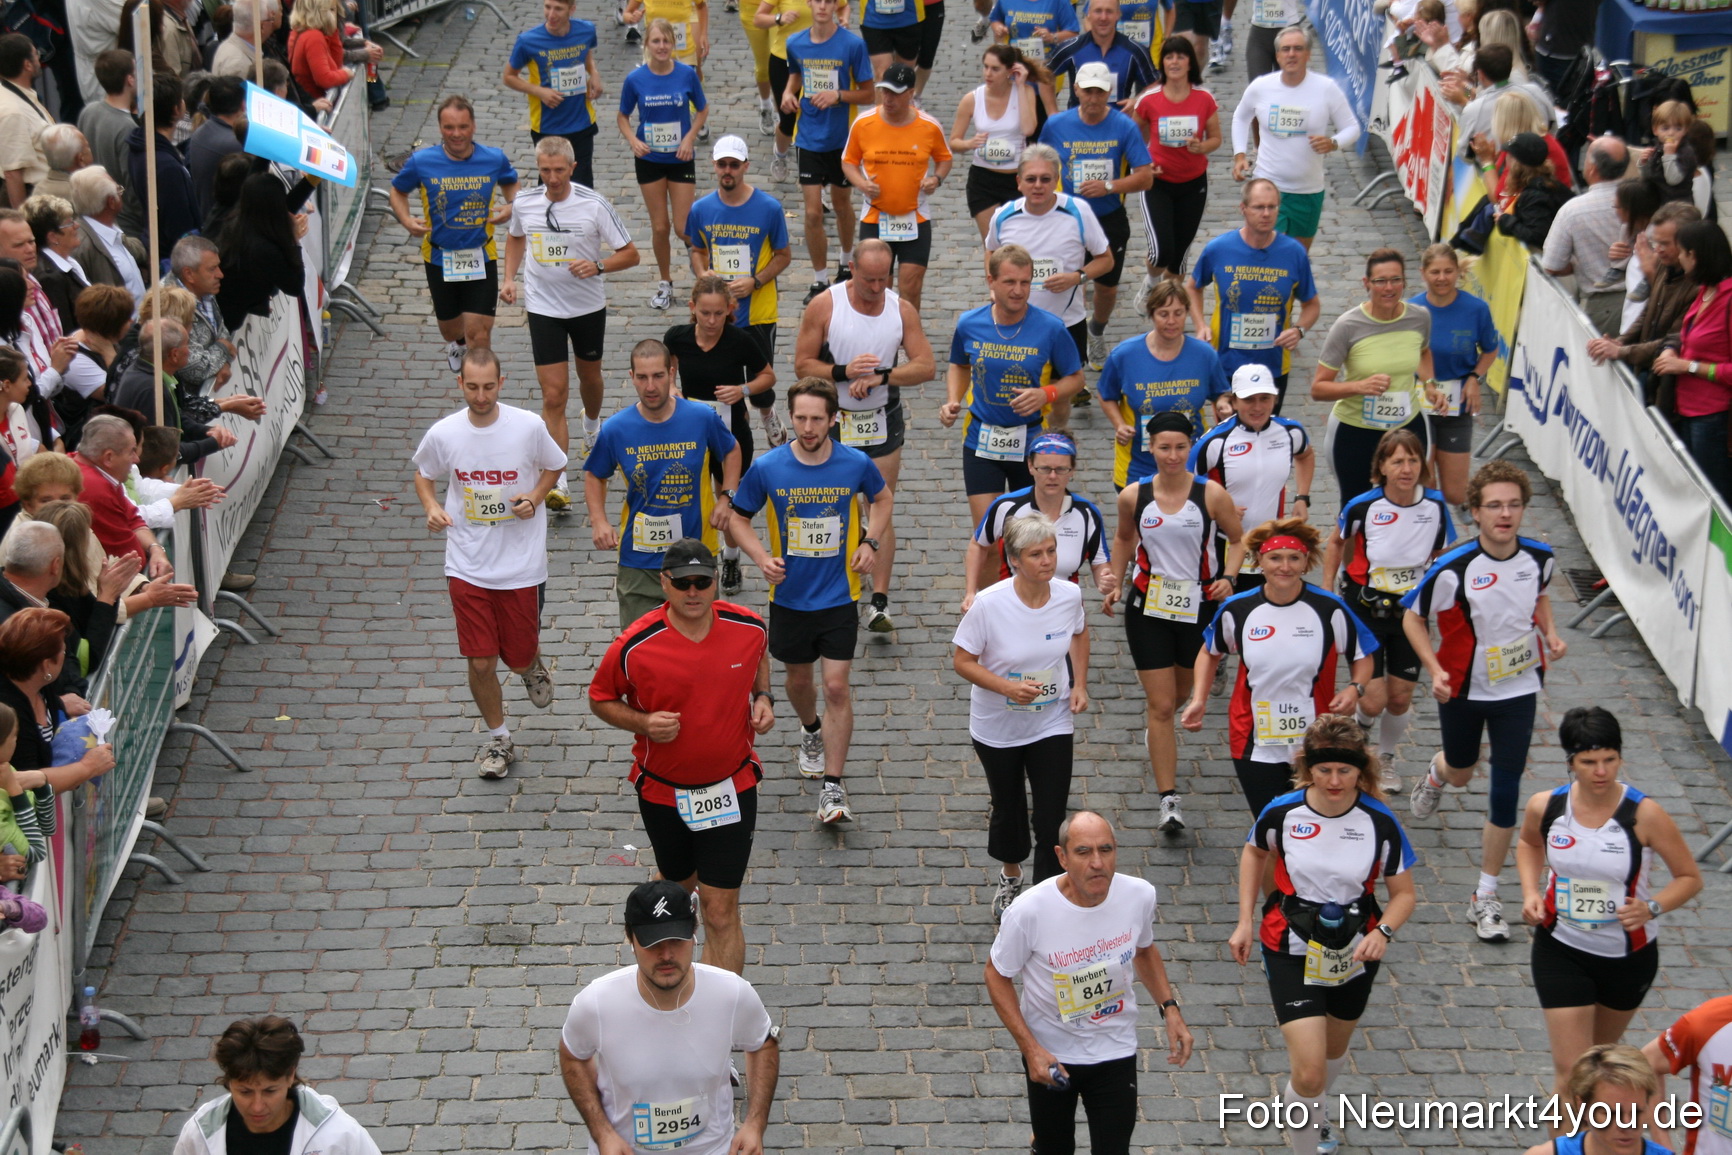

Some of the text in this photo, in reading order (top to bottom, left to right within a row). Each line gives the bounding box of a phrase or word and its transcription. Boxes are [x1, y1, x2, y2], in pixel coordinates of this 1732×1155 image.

[1264, 10, 1284, 18] 3058
[548, 44, 586, 56] NEUMARKTER
[548, 51, 581, 62] STADTLAUF
[803, 58, 843, 67] NEUMARKTER
[562, 77, 582, 87] 3707
[1690, 71, 1725, 87] Bier
[813, 81, 834, 90] 2668
[1280, 117, 1304, 127] 3537
[655, 133, 677, 143] 2324
[1170, 128, 1193, 137] 3335
[1073, 140, 1118, 148] NEUMARKTER
[988, 148, 1011, 157] 3062
[1071, 147, 1109, 155] STADTLAUF
[442, 176, 491, 185] NEUMARKTER
[1085, 172, 1109, 181] 3522
[440, 183, 483, 191] STADTLAUF
[712, 224, 760, 235] NEUMARKTER
[890, 222, 913, 232] 2992
[711, 231, 750, 240] STADTLAUF
[454, 251, 474, 259] Thomas
[548, 246, 569, 256] 987
[719, 248, 740, 256] Dominik
[455, 259, 480, 270] 2743
[726, 259, 740, 269] 19
[1033, 267, 1058, 278] 3518
[1224, 265, 1289, 277] 10. NEUMARKTER
[1233, 273, 1279, 283] STADTLAUF
[1243, 317, 1265, 325] Michael
[1243, 327, 1270, 337] 2221
[972, 341, 1039, 356] 10. NEUMARKTER
[979, 349, 1027, 362] STADTLAUF
[1135, 379, 1200, 391] 10. NEUMARKTER
[1145, 387, 1192, 398] STADTLAUF
[851, 412, 874, 421] Michael
[1376, 405, 1406, 417] 2223
[857, 422, 879, 434] 823
[625, 441, 697, 455] 10. NEUMARKTER
[991, 437, 1021, 449] 3548
[636, 450, 686, 463] STADTLAUF
[454, 468, 519, 485] kago
[474, 492, 493, 501] Peter
[776, 487, 851, 497] 10. NEUMARKTER
[788, 495, 840, 505] STADTLAUF
[480, 502, 506, 515] 269
[644, 517, 671, 527] Dominik
[1143, 517, 1158, 525] tkn
[1373, 512, 1392, 521] tkn
[801, 520, 825, 530] Stefan
[649, 529, 673, 541] 251
[807, 532, 832, 545] 187
[1392, 569, 1417, 585] 352
[1472, 576, 1490, 585] tkn
[1162, 580, 1182, 592] Heike
[1165, 594, 1191, 609] 323
[1250, 626, 1268, 636] tkn
[1501, 644, 1524, 657] Stefan
[1508, 649, 1533, 667] 449
[1279, 703, 1299, 714] Ute
[1279, 717, 1307, 730] 305
[694, 794, 732, 815] 2083
[1292, 823, 1312, 834] tkn
[1551, 835, 1570, 845] tkn
[1575, 899, 1617, 914] 2739
[1096, 928, 1132, 954] Silvesterlauf
[1072, 967, 1107, 985] Herbert
[1082, 978, 1113, 1000] 847
[654, 1104, 683, 1117] Bernd
[656, 1113, 702, 1135] 2954
